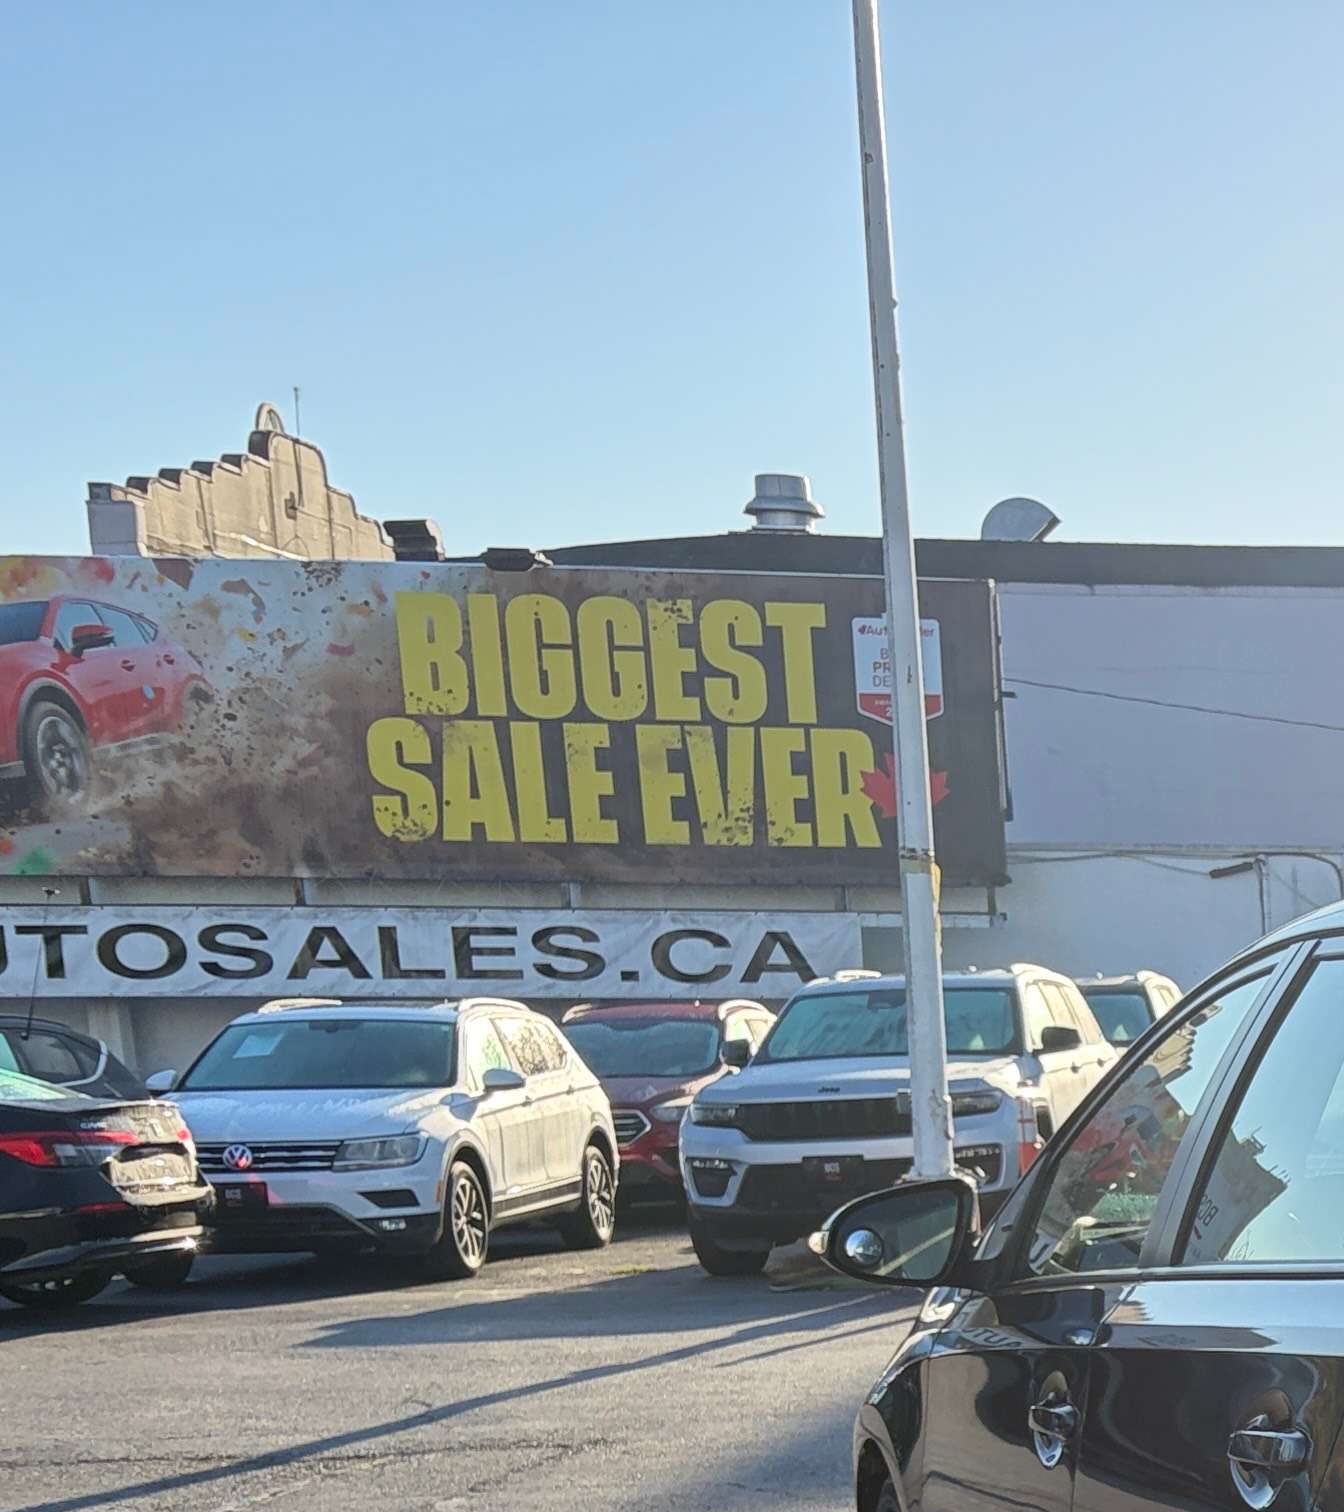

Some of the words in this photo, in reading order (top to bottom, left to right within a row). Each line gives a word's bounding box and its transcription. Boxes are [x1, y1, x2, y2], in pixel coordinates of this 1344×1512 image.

[395, 591, 827, 724] BIGGEST
[366, 717, 620, 844] SALE
[635, 723, 883, 848] EVER
[0, 923, 818, 983] TOSALES.CA
